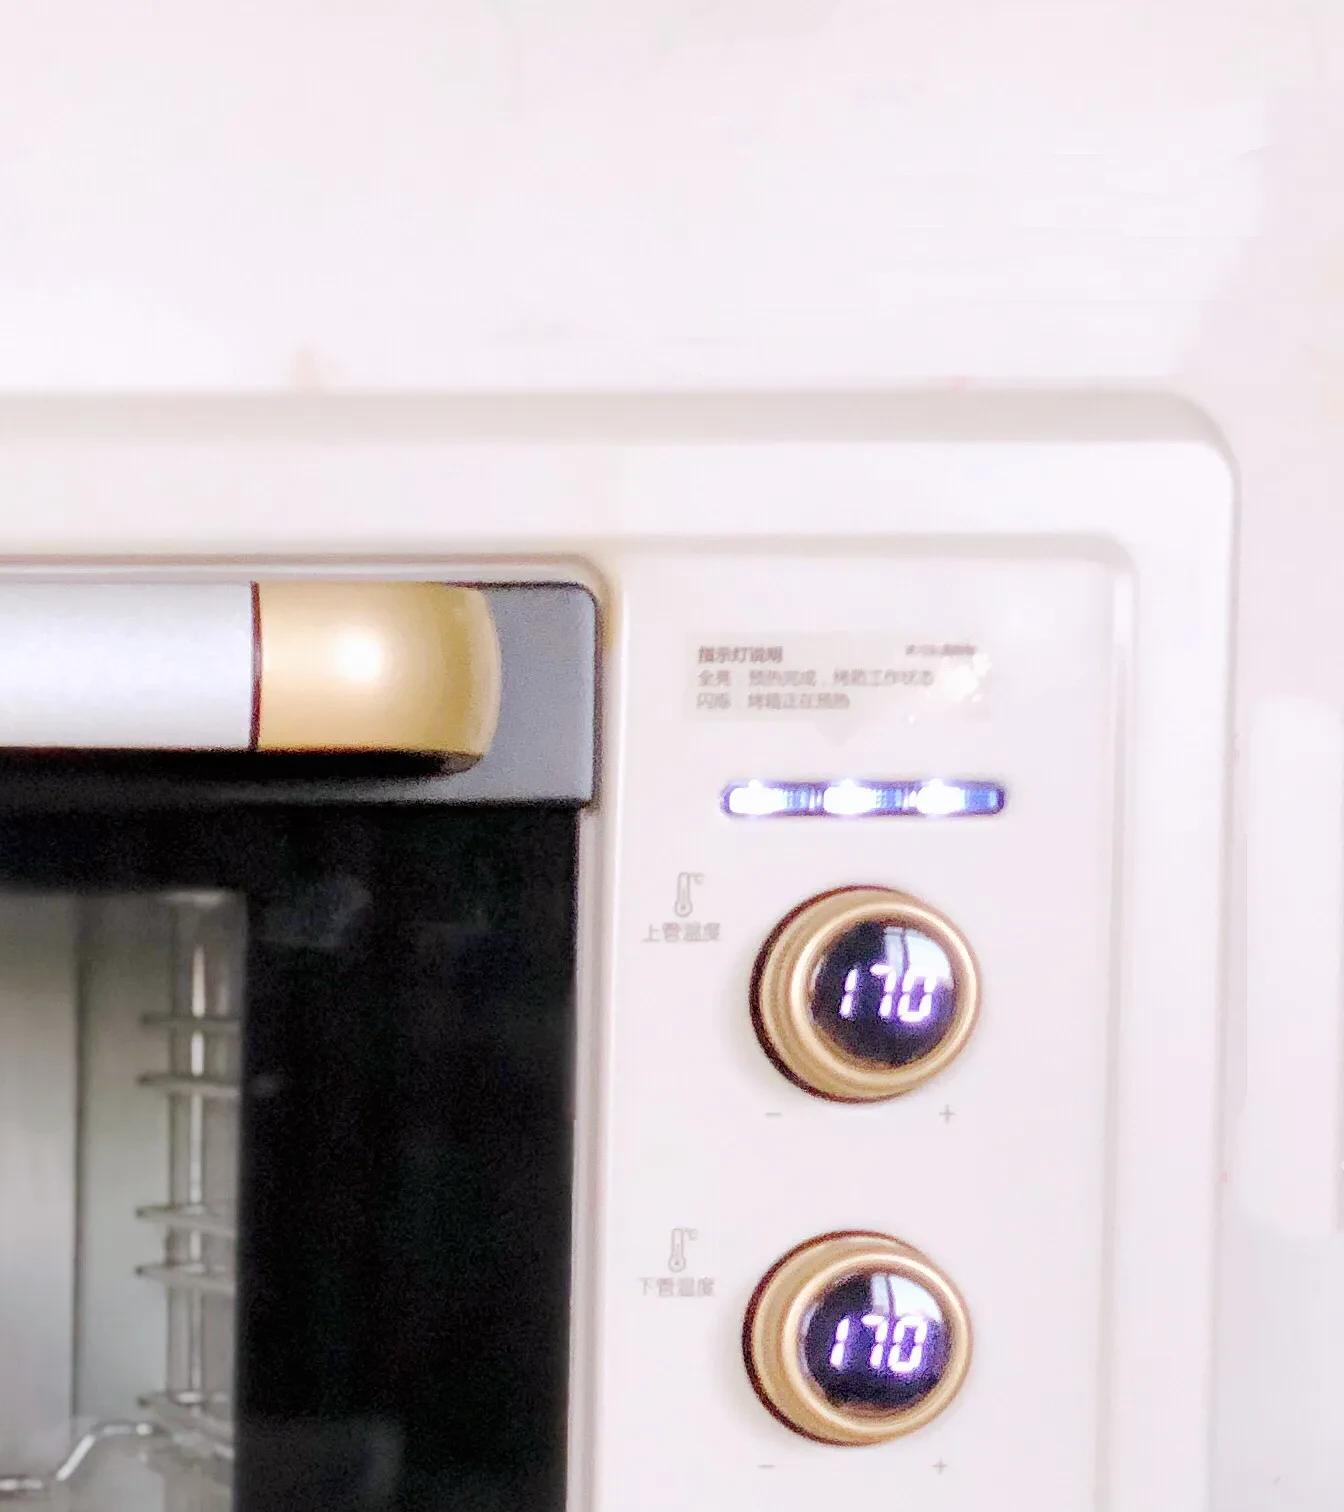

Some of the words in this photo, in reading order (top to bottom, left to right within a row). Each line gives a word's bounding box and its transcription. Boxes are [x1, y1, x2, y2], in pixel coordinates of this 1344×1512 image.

[642, 922, 721, 942] 上管温度
[839, 963, 937, 1023] 170
[639, 1277, 715, 1297] 下管温度
[829, 1314, 927, 1374] 170
